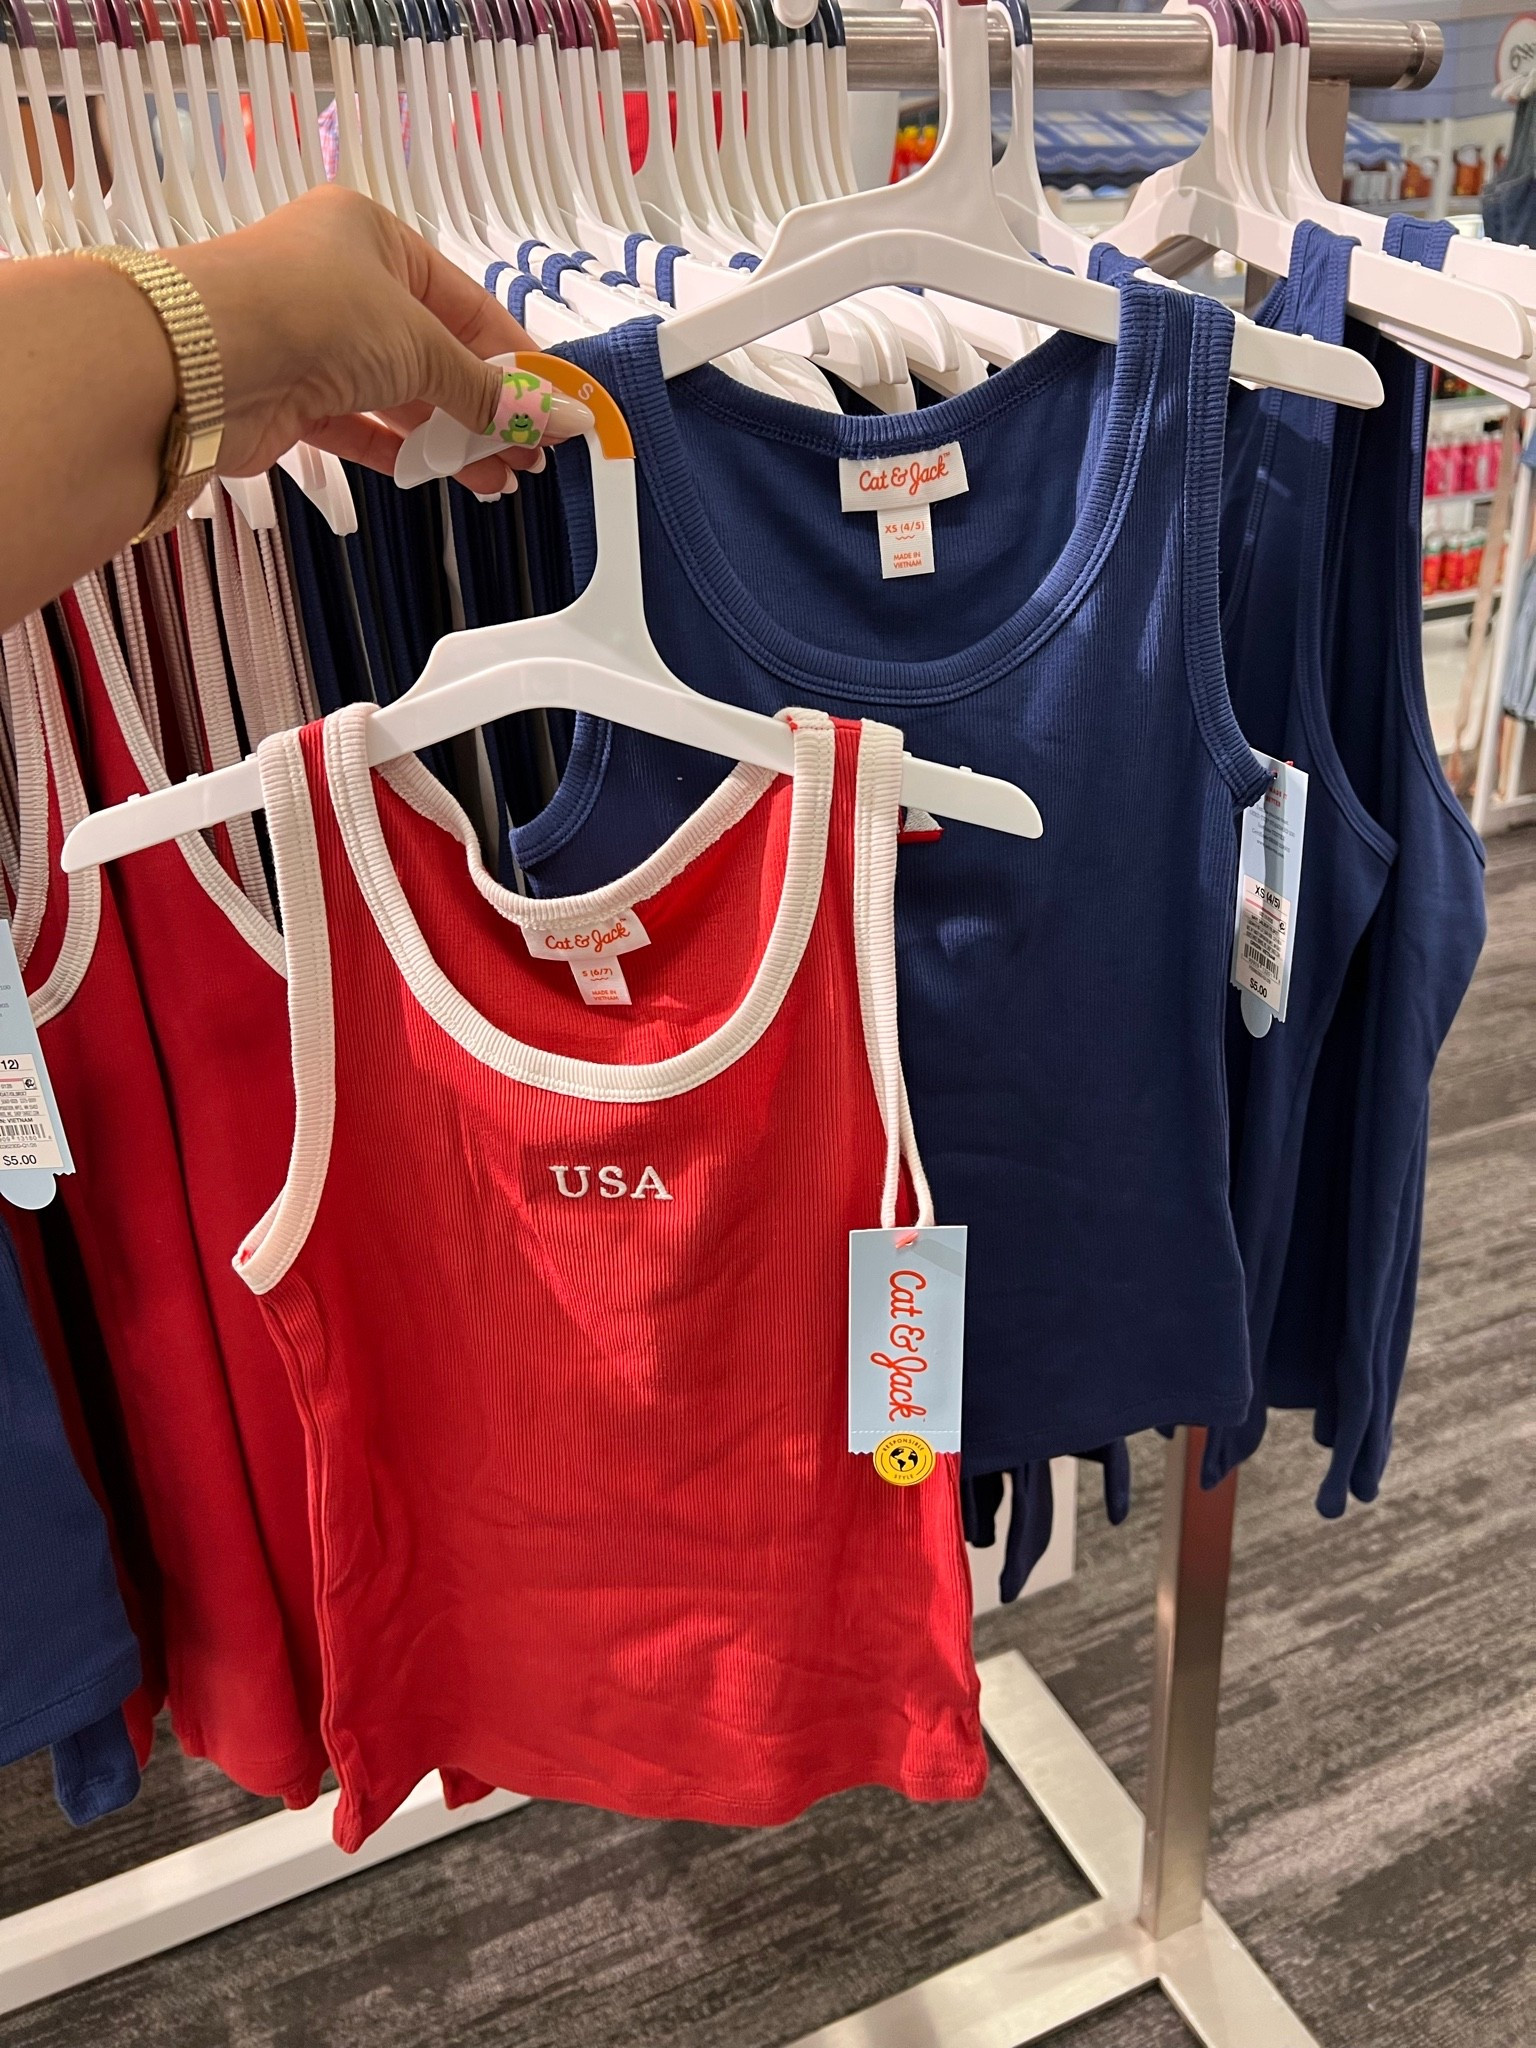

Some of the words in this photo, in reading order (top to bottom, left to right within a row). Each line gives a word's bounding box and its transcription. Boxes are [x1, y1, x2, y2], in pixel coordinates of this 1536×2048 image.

[578, 383, 593, 400] S
[860, 470, 889, 491] Cat
[891, 467, 908, 487] &
[909, 455, 949, 495] Jack
[885, 525, 897, 533] XS
[900, 521, 925, 534] (4/5)
[893, 553, 912, 561] MADE
[893, 560, 922, 569] VIETNAM
[1255, 885, 1265, 899] XS
[1266, 891, 1280, 909] (4/5)
[545, 935, 574, 950] Cat
[574, 934, 589, 948] &
[591, 922, 630, 953] Jack
[590, 968, 613, 978] (6/7)
[1249, 977, 1268, 998] $5.00
[3, 1154, 37, 1166] $5.00
[548, 1165, 674, 1201] USA
[889, 1270, 927, 1319] Cat
[890, 1324, 925, 1352] &
[870, 1352, 928, 1422] Jack
[882, 1438, 924, 1451] RESPONSIBLE
